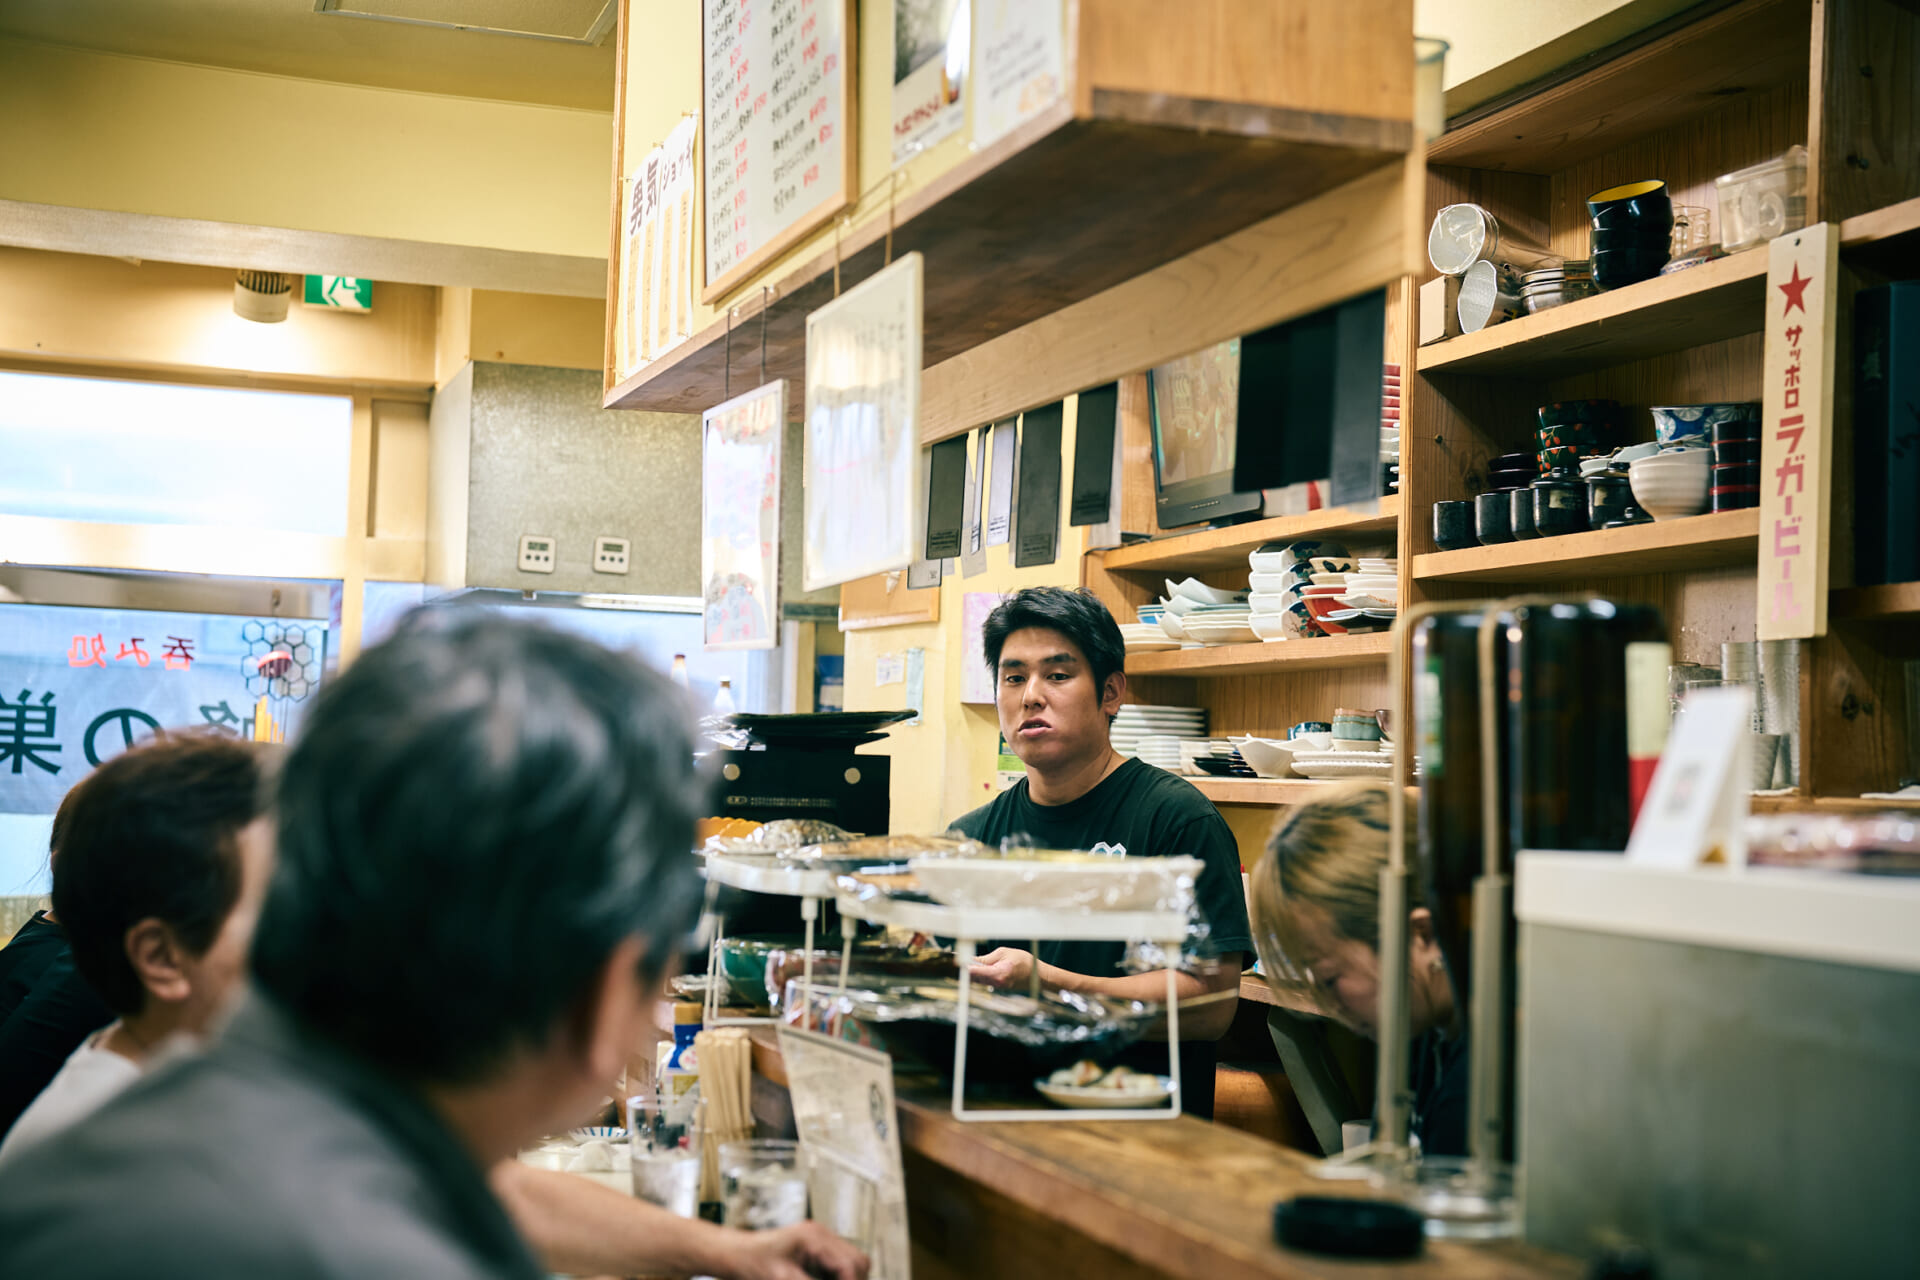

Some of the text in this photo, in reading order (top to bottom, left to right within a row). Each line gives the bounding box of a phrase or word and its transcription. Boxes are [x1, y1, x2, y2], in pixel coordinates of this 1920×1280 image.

[1770, 324, 1807, 622] サッポロラガービール
